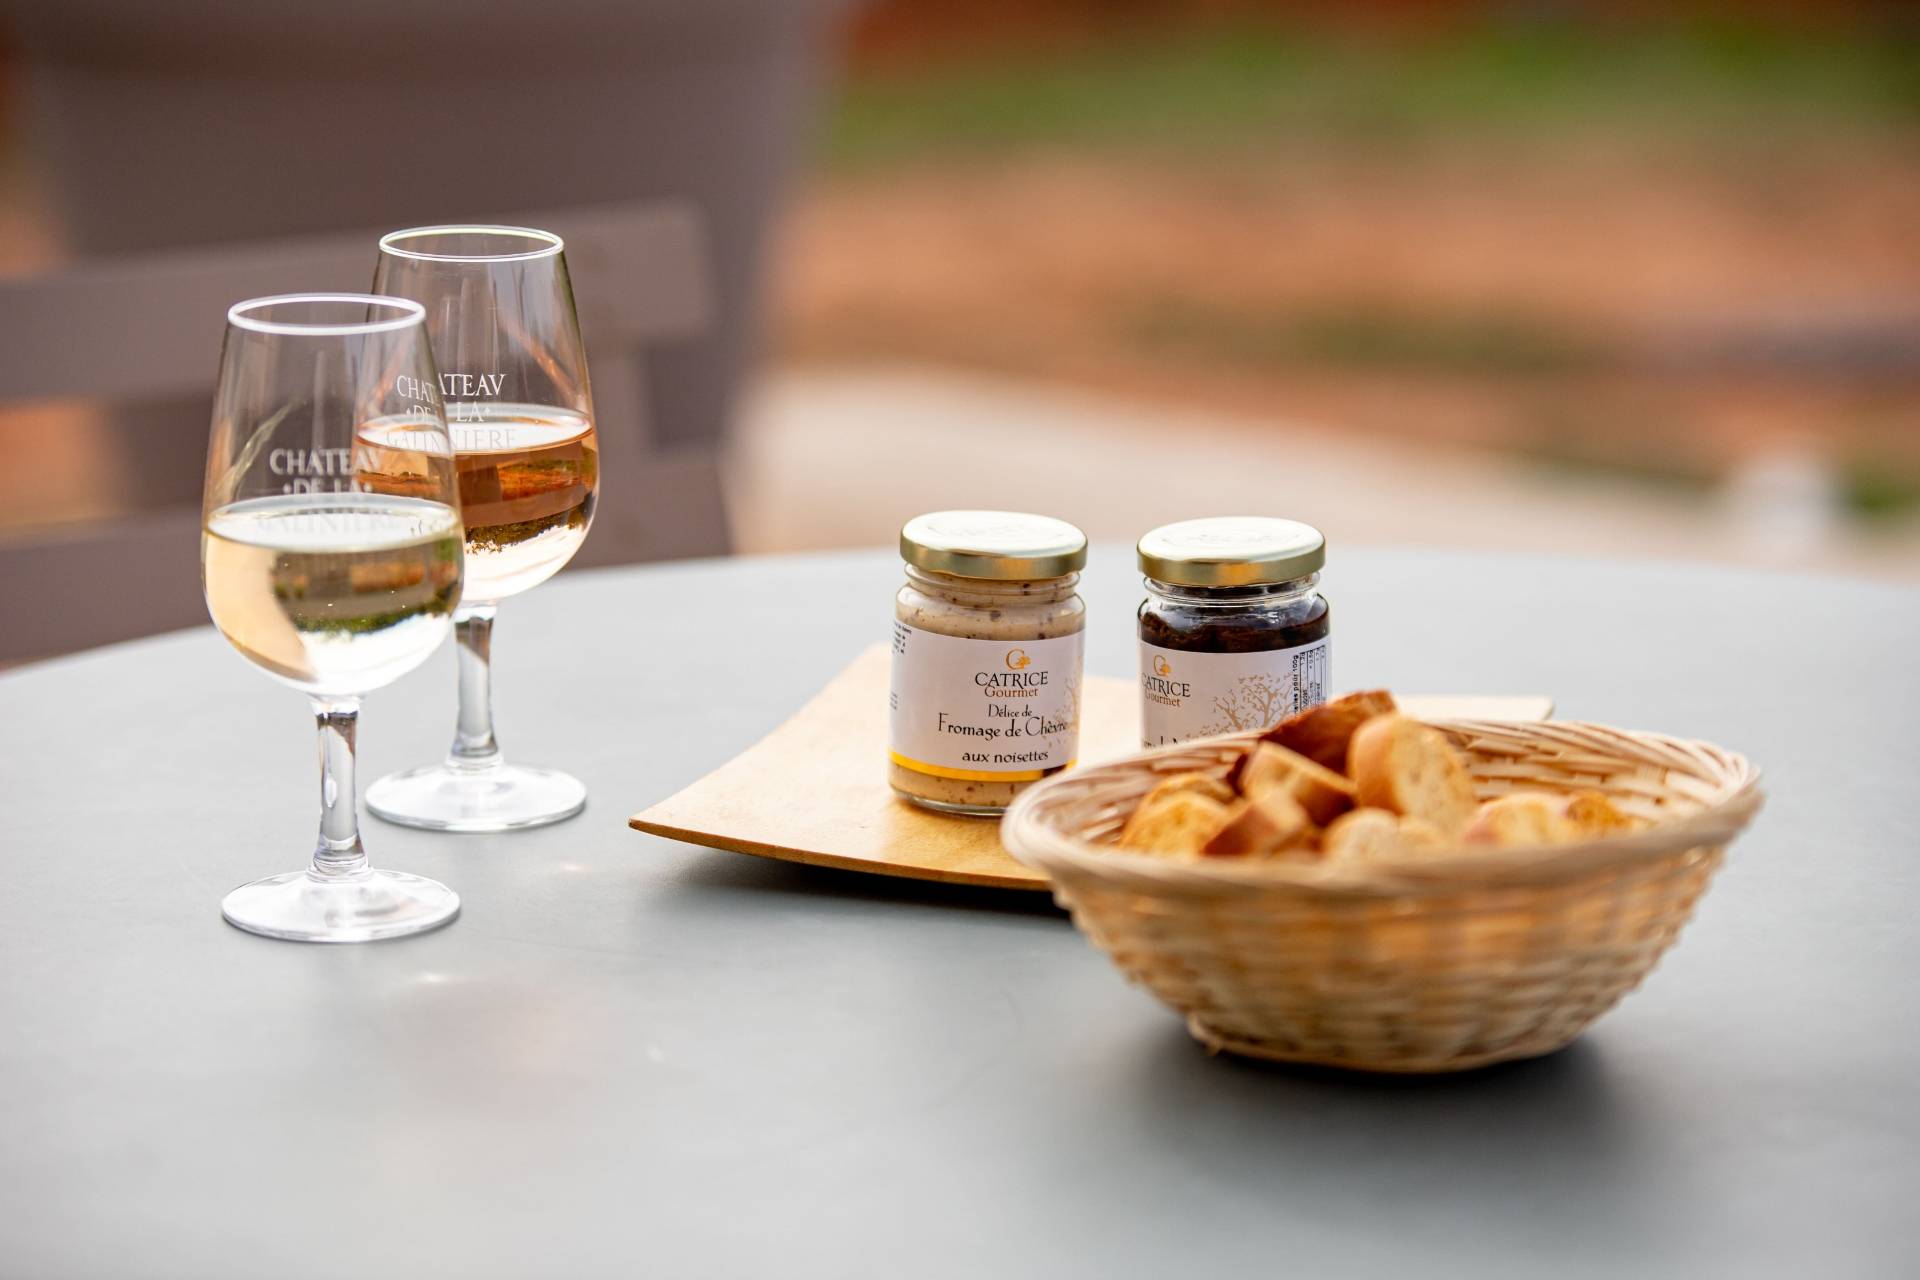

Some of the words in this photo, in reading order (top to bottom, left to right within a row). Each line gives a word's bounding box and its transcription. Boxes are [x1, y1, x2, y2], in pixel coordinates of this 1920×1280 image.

[456, 401, 485, 422] LA
[269, 448, 381, 476] CHATEAV
[975, 671, 1049, 689] CATRICE
[1142, 673, 1191, 698] CATRICE
[984, 685, 1039, 698] Gourmet
[988, 704, 1020, 718] Délice
[1022, 704, 1033, 717] de
[938, 712, 1000, 741] Fromage
[1005, 719, 1022, 738] de
[962, 752, 990, 763] aux
[994, 751, 1049, 763] noisettes
